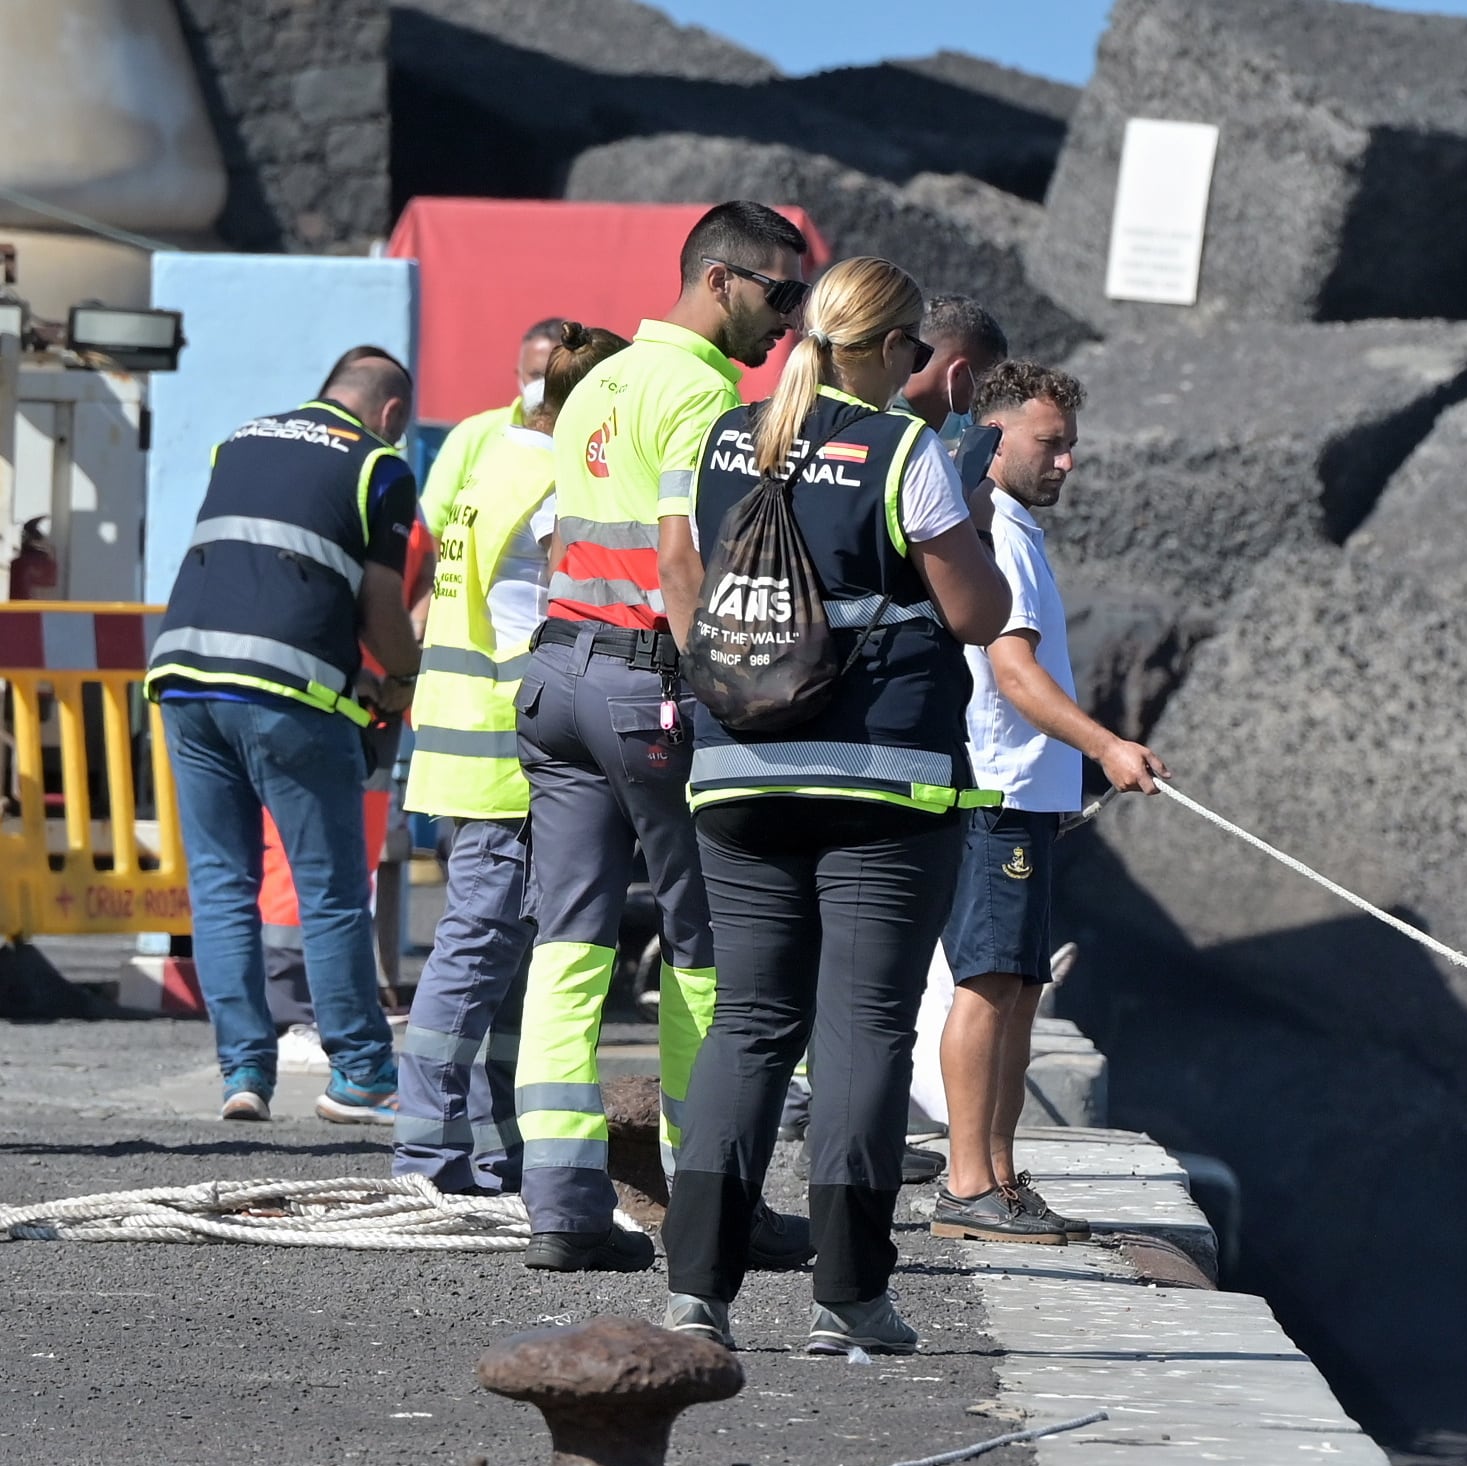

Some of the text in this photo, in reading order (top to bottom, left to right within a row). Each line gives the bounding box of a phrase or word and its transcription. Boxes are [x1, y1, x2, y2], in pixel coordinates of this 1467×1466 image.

[230, 424, 349, 453] NACIONAL
[708, 572, 792, 622] VANS
[721, 629, 749, 645] THE
